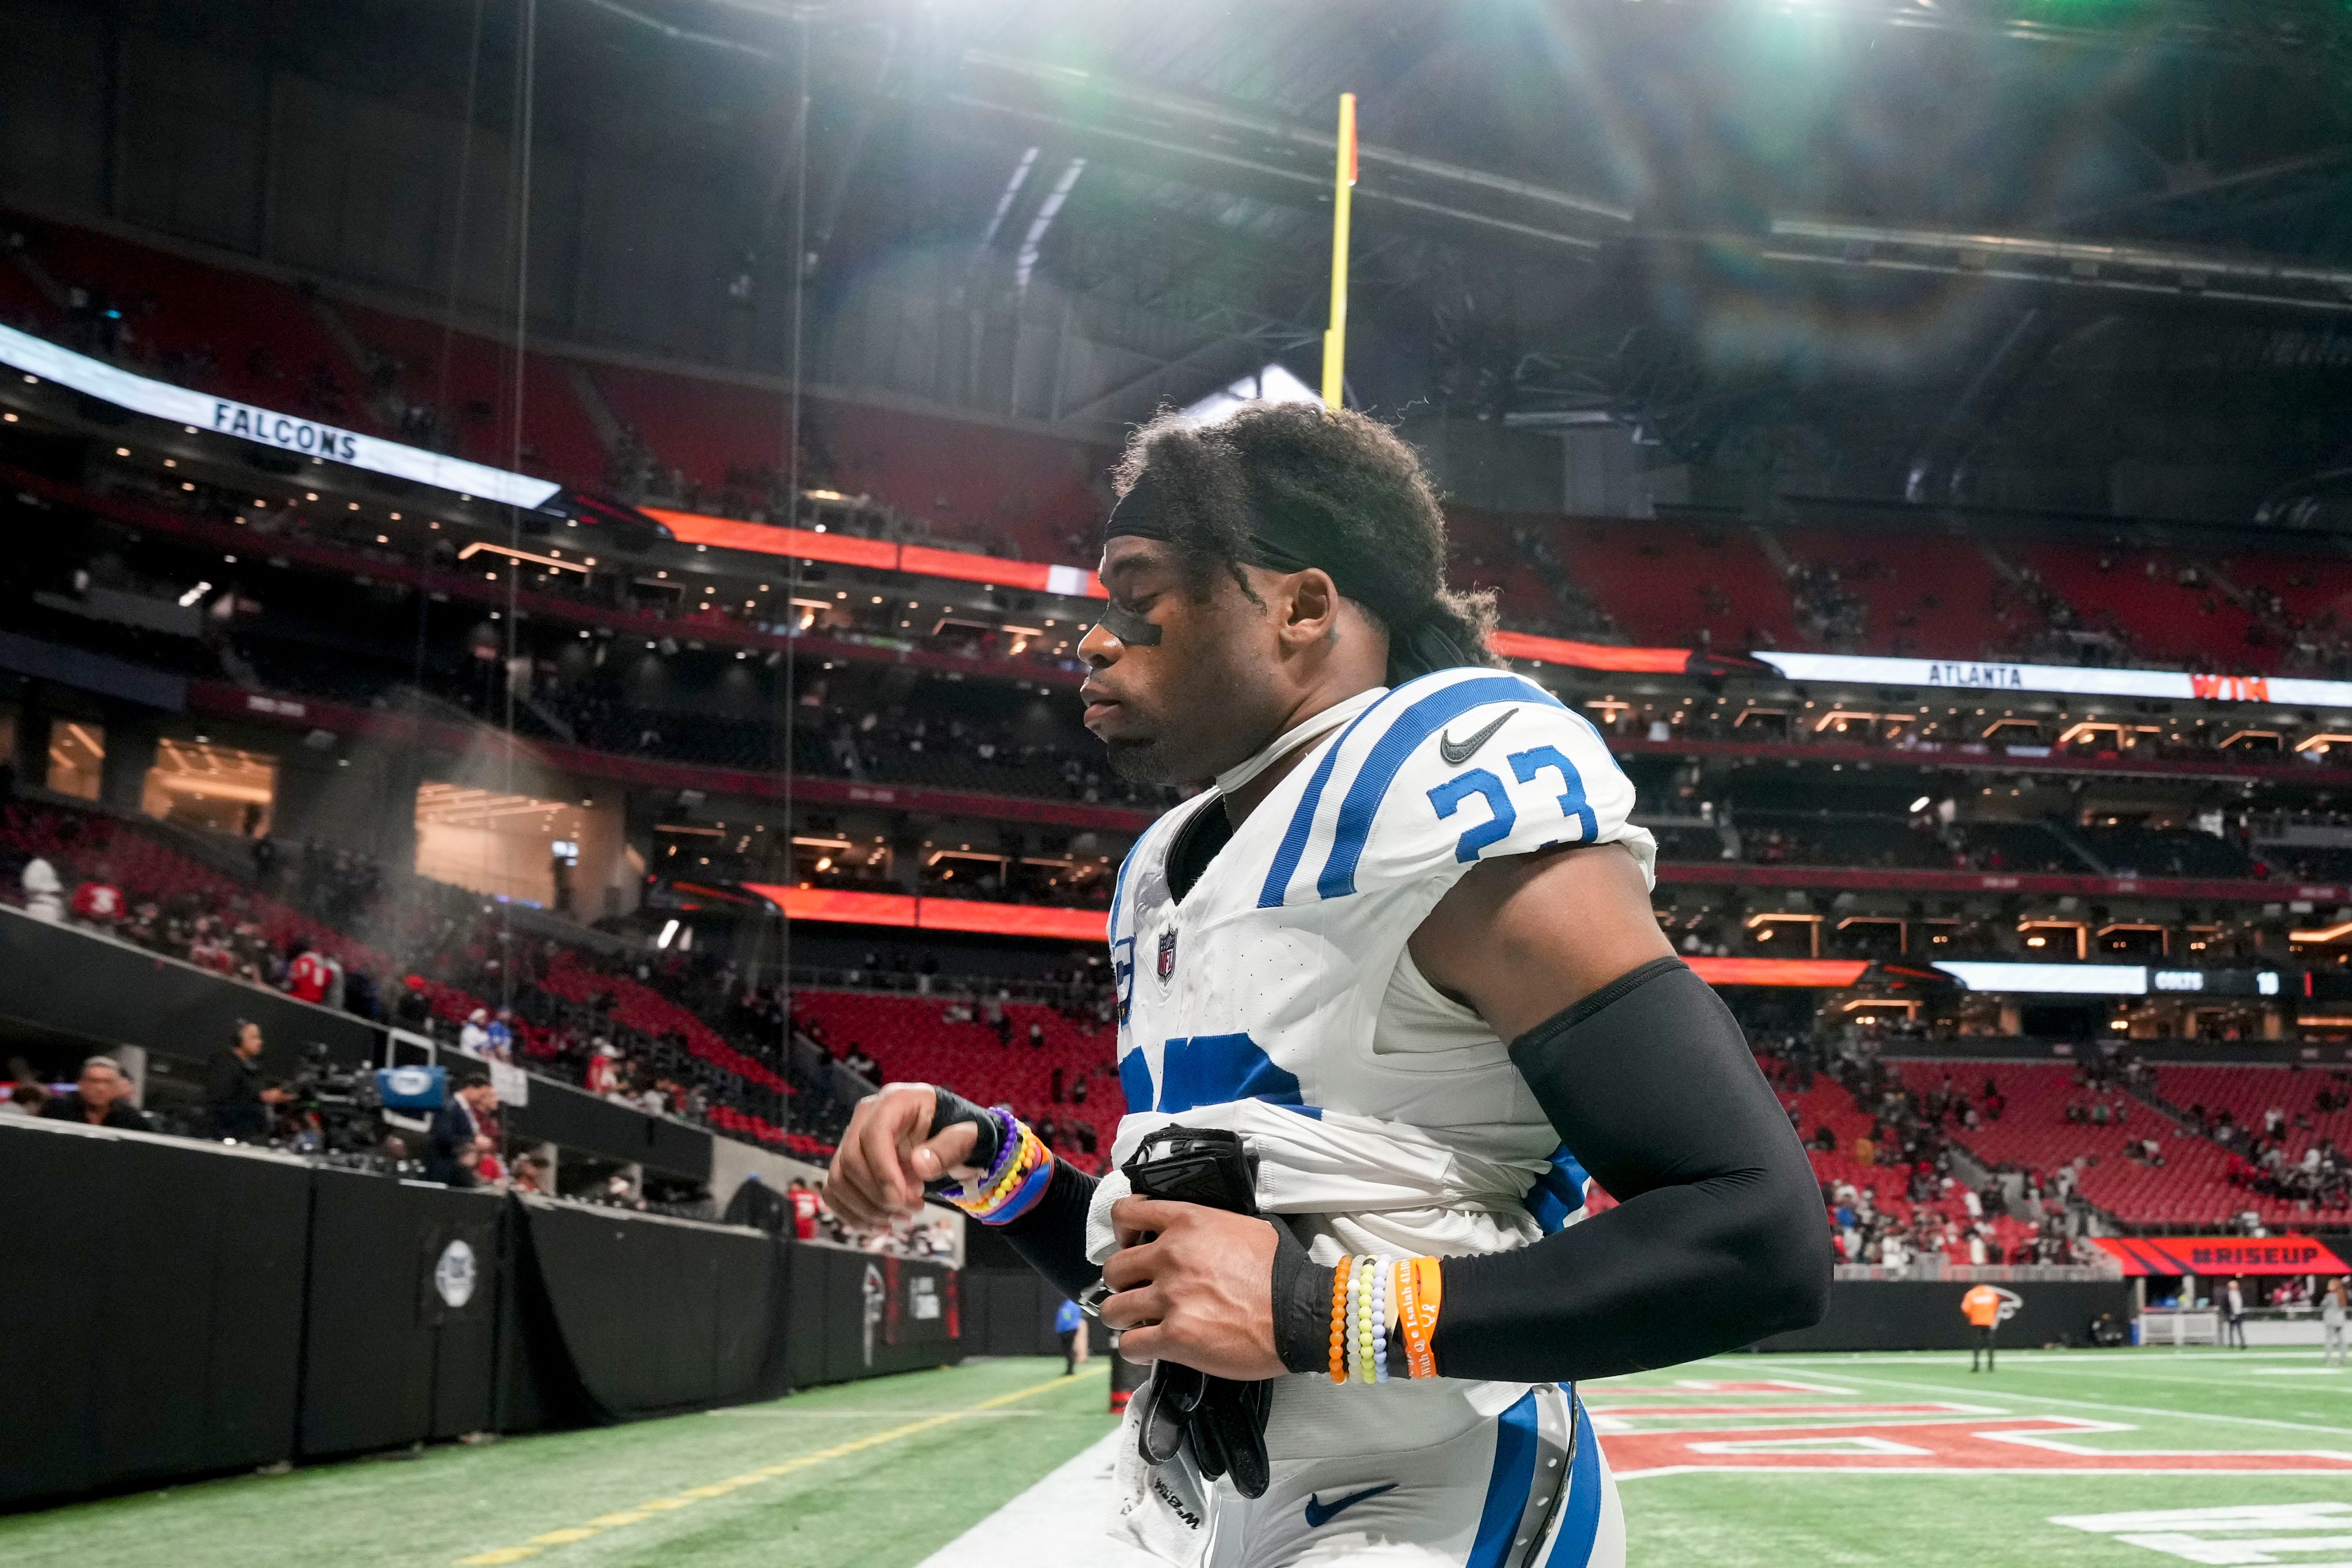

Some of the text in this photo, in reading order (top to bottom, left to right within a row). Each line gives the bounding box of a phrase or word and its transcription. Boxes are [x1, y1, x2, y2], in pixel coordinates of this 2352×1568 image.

[214, 403, 355, 459] FALCONS
[1929, 664, 2270, 702] ATLANTA WIN
[1427, 745, 1598, 864] 23
[1161, 950, 1173, 974] NFL
[1400, 1260, 1411, 1284] 41:10
[2192, 1247, 2318, 1264] #RISEUP
[1401, 1286, 1418, 1328] Isaiah
